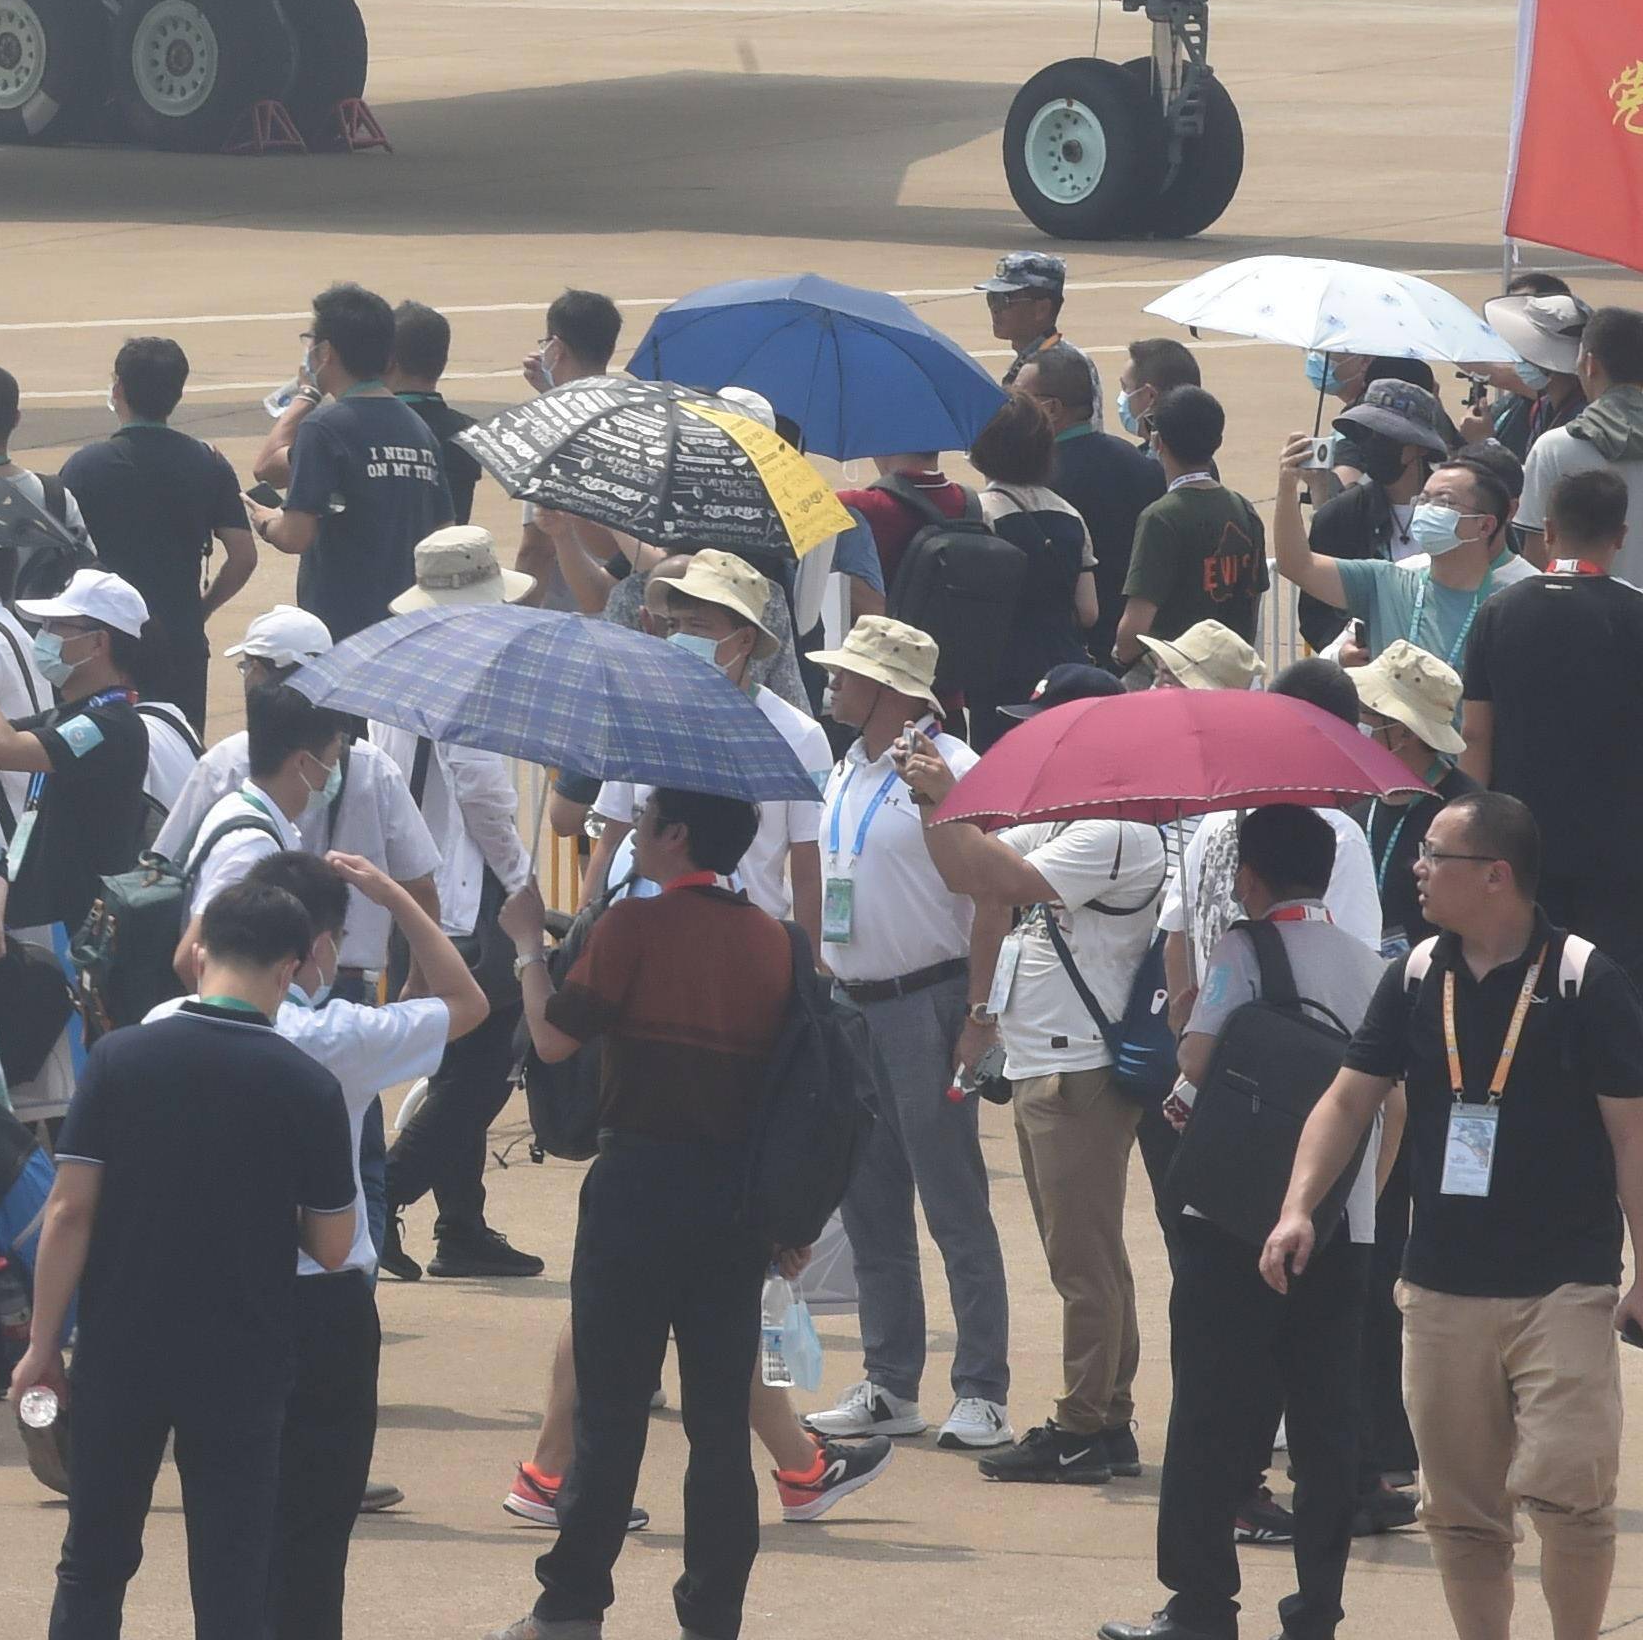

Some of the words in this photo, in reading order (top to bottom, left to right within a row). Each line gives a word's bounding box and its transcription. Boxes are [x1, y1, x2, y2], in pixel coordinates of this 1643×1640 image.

[383, 446, 417, 462] NEED
[367, 463, 388, 478] ON
[392, 463, 411, 477] MY
